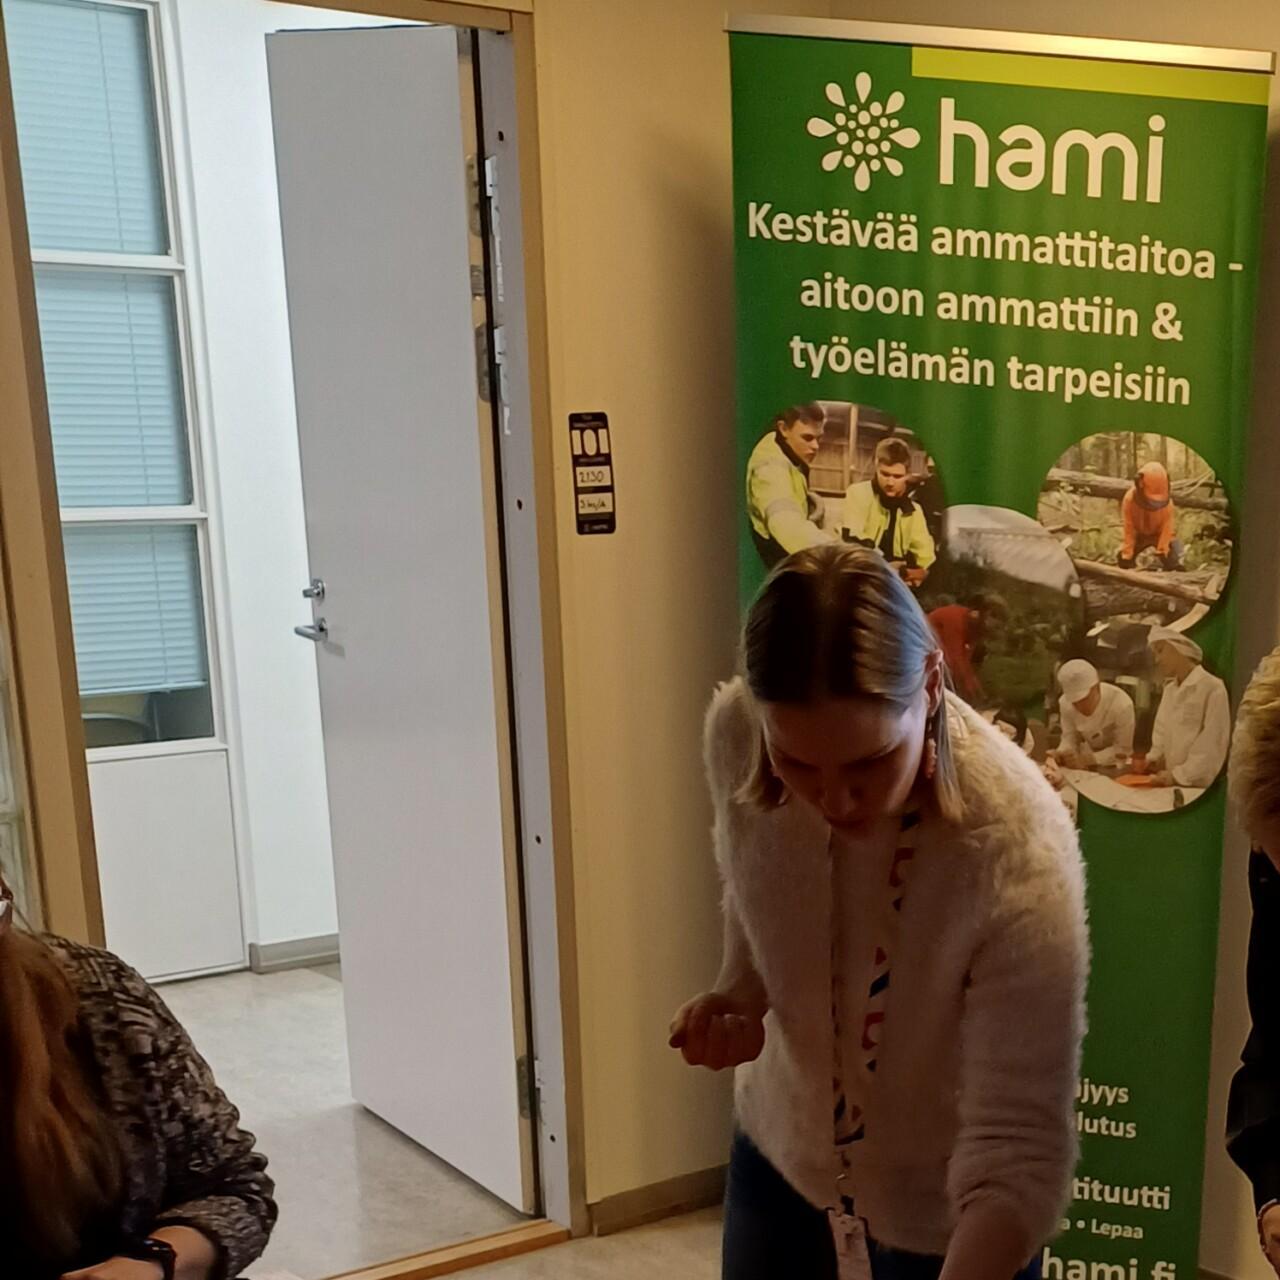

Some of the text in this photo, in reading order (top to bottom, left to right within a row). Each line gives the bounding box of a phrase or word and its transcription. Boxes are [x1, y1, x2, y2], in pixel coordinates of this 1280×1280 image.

[938, 97, 1166, 203] hami
[747, 202, 919, 253] Kestävää
[930, 225, 1217, 280] ammattitaitoa
[800, 272, 1184, 342] aitoon ammattiin &
[789, 335, 1192, 406] työelämän tarpeisiin
[1076, 1078, 1130, 1107] jyys
[1077, 1111, 1137, 1139] lutus
[1072, 1176, 1171, 1211] tituutti
[1091, 1219, 1144, 1240] Lepaa
